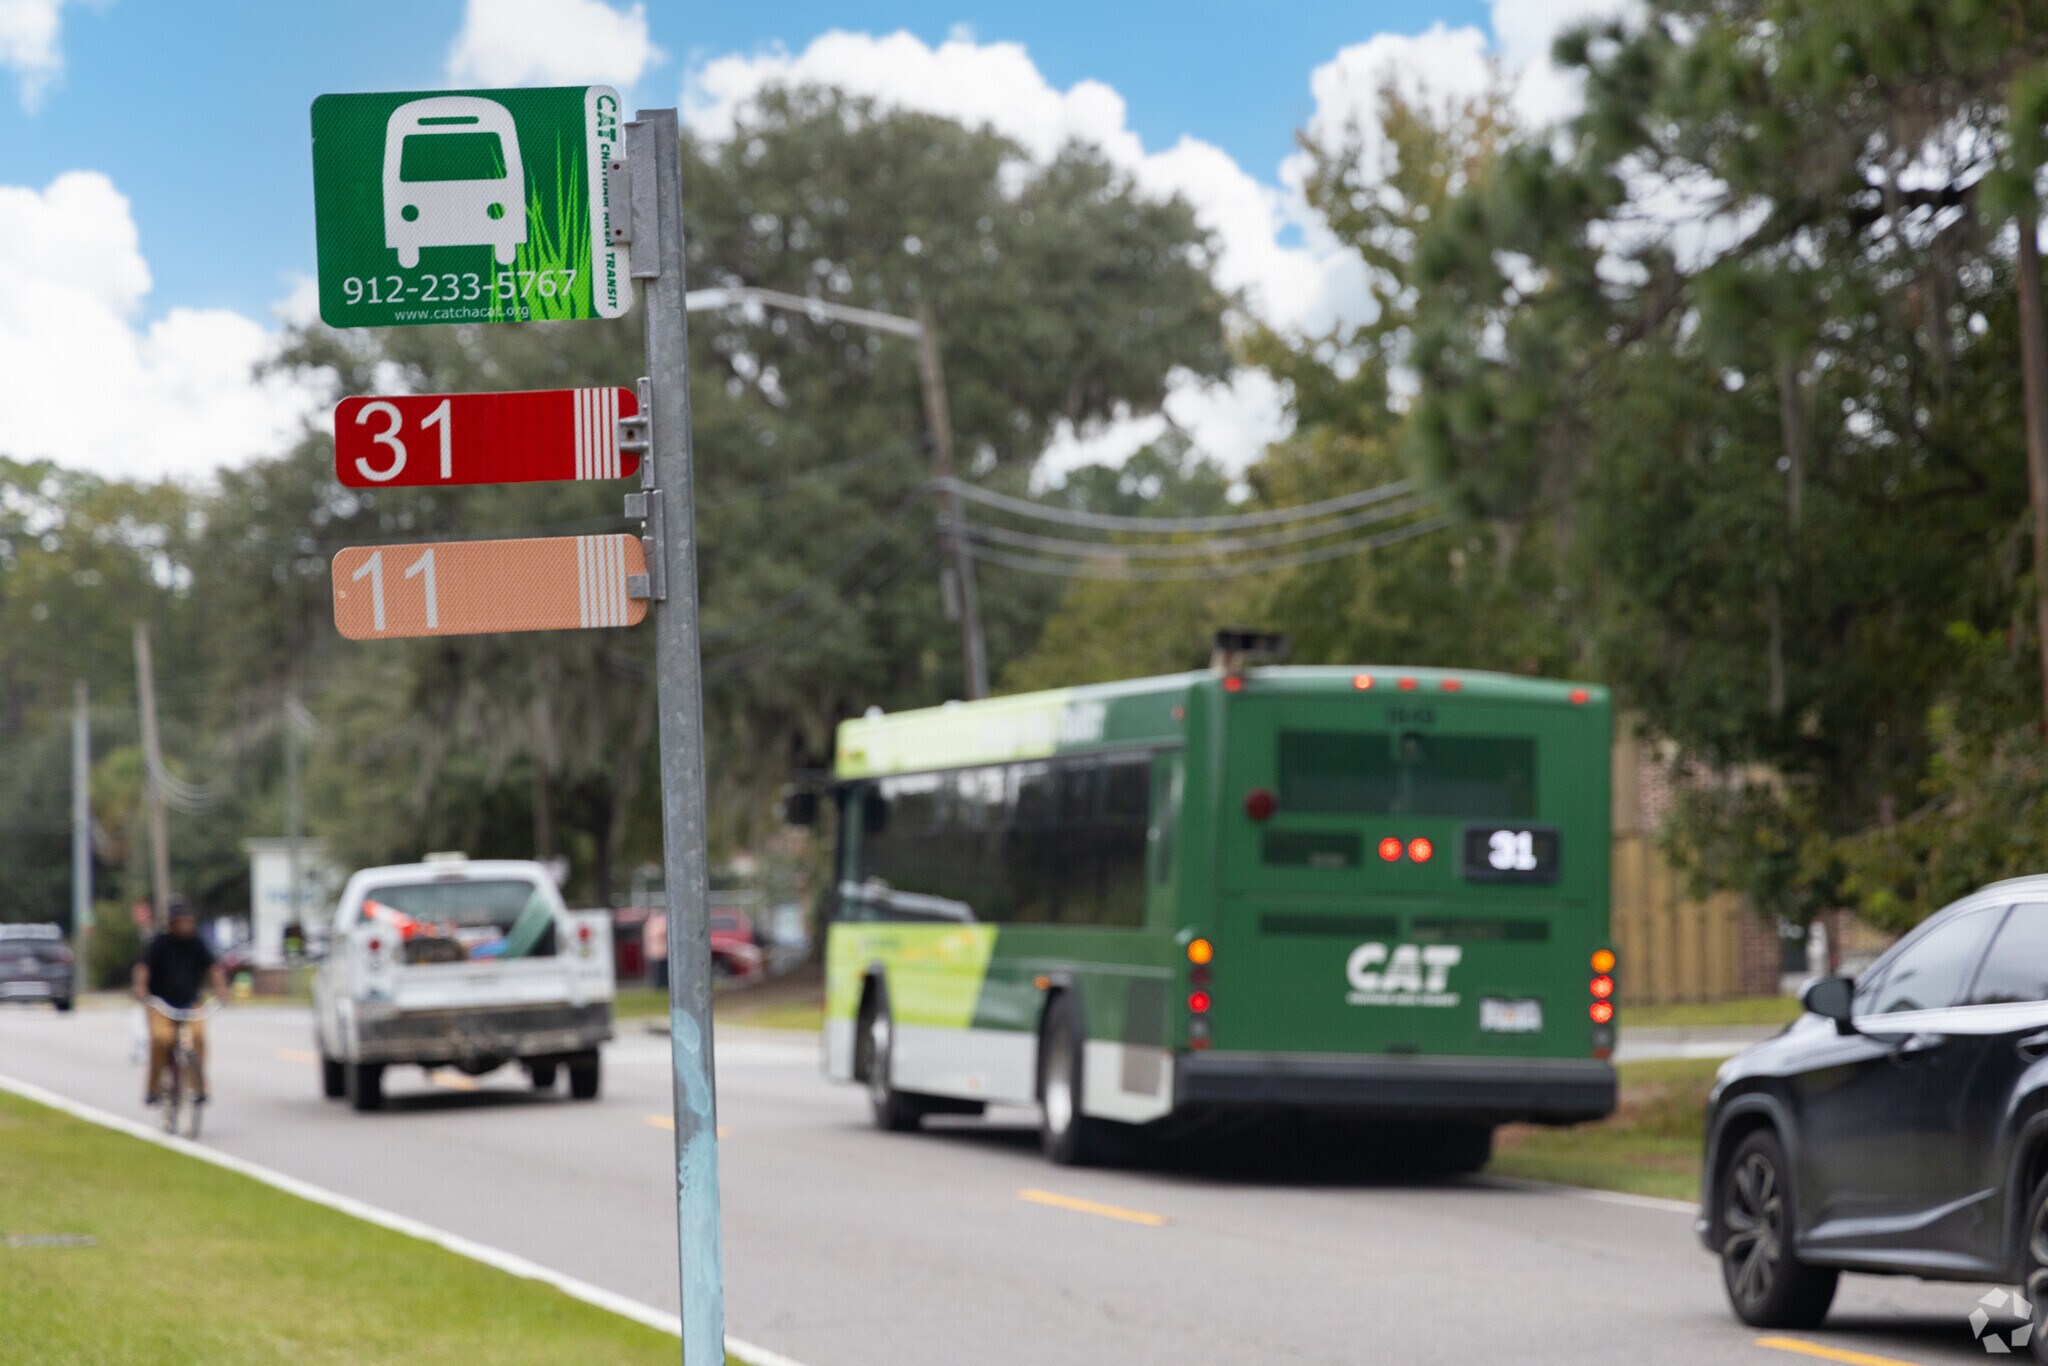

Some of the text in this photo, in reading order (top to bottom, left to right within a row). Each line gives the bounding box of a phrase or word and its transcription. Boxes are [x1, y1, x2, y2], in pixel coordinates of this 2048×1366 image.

[597, 95, 617, 142] CAT
[343, 269, 577, 305] 912-233-5767
[606, 252, 618, 309] TRANSIT
[394, 305, 530, 322] www.catchacat.org
[355, 399, 452, 482] 31
[352, 548, 439, 632] 11
[1488, 829, 1537, 871] 31
[1345, 942, 1463, 993] CAT
